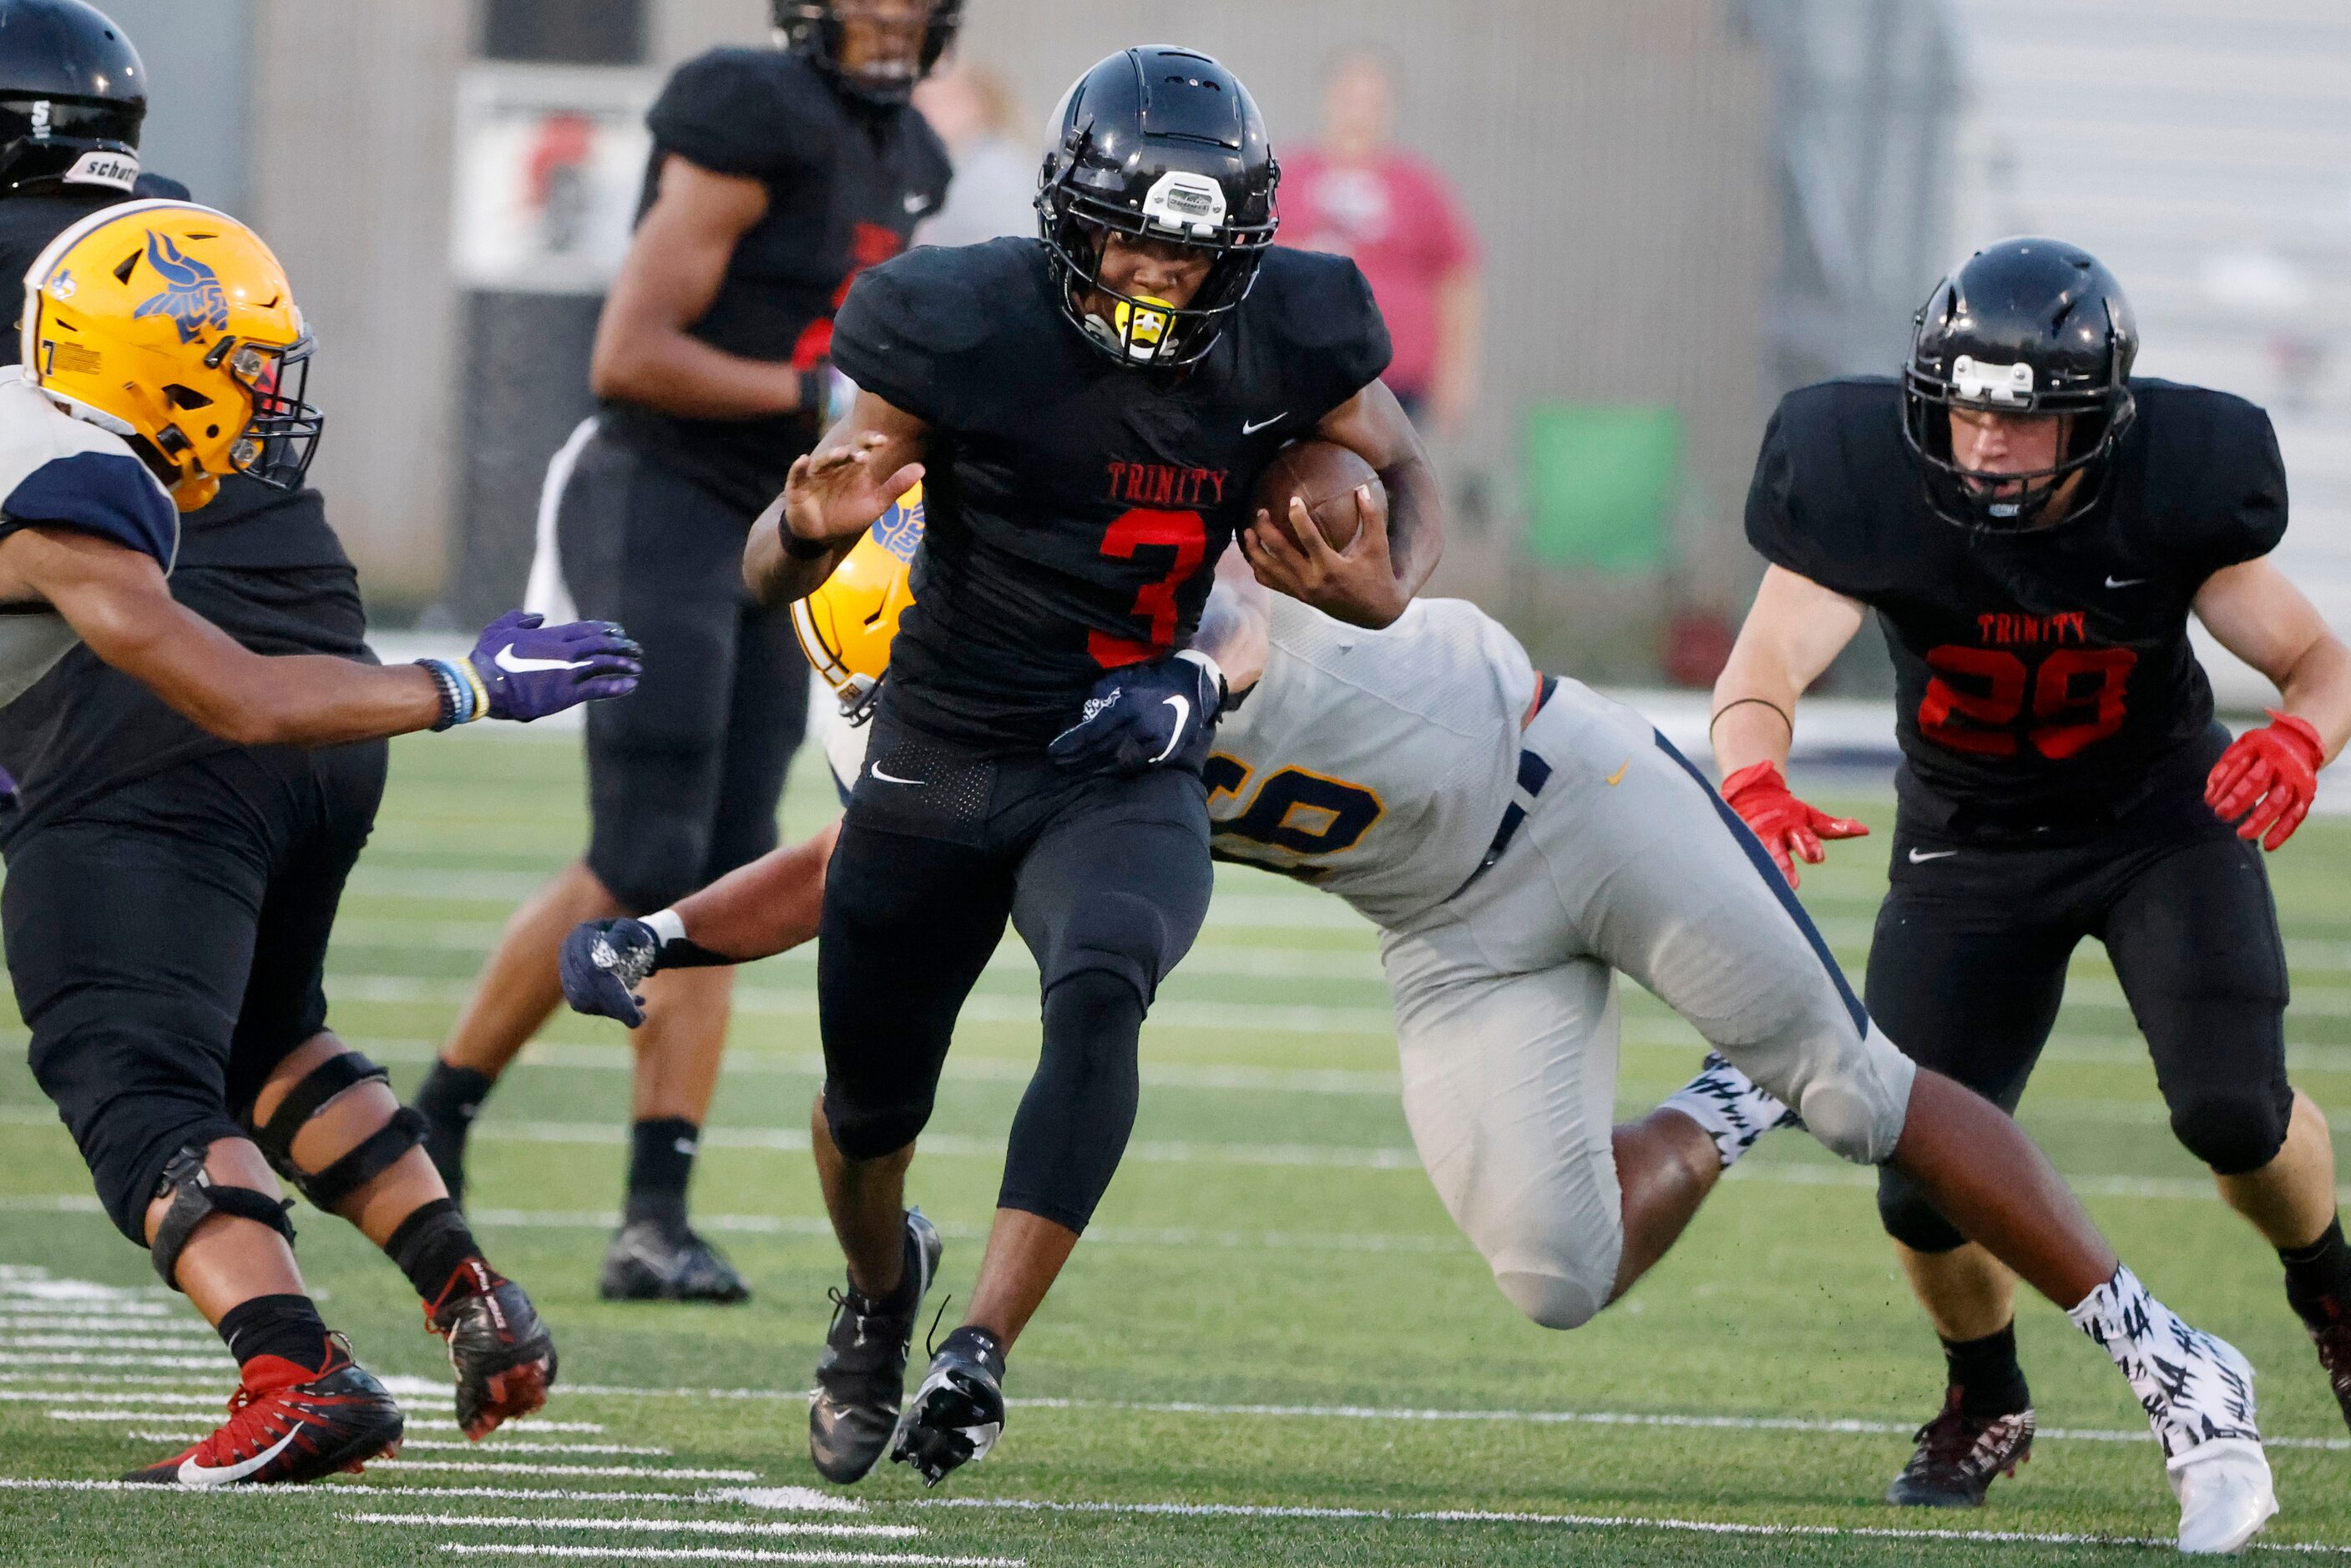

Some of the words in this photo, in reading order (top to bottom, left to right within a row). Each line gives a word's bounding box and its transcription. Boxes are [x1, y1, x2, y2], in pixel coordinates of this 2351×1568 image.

[42, 339, 55, 377] 7
[1107, 461, 1229, 503] TRINITY
[1087, 508, 1207, 669] 3
[1977, 610, 2086, 644] TRINITY
[1918, 644, 2137, 760] 29
